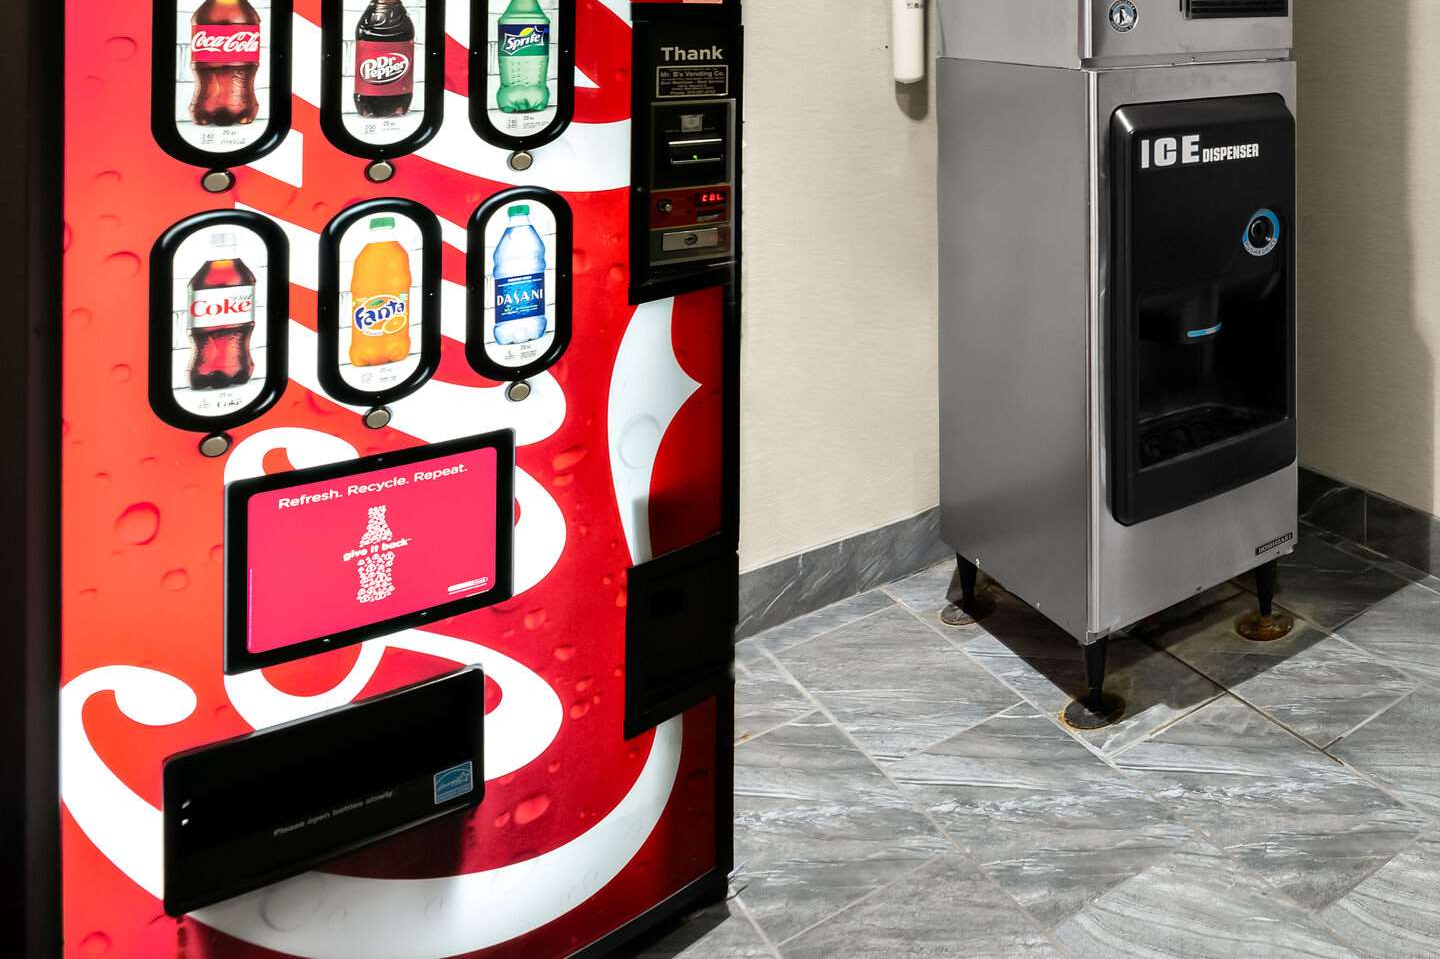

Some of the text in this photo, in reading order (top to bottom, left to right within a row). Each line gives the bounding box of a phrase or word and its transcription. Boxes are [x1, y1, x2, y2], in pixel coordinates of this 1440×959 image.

[191, 30, 260, 53] Coca-Cola
[505, 32, 541, 51] Sprite
[376, 56, 397, 67] Dr
[660, 45, 724, 61] Thank
[364, 58, 407, 80] Pepper
[1140, 134, 1260, 169] ICE DISPENSER
[496, 288, 544, 306] DASANI
[190, 298, 252, 318] Coke
[354, 300, 405, 329] Fanta
[278, 462, 468, 510] Refresh. Recycle. Repeat.
[342, 548, 368, 562] give
[370, 543, 380, 554] it
